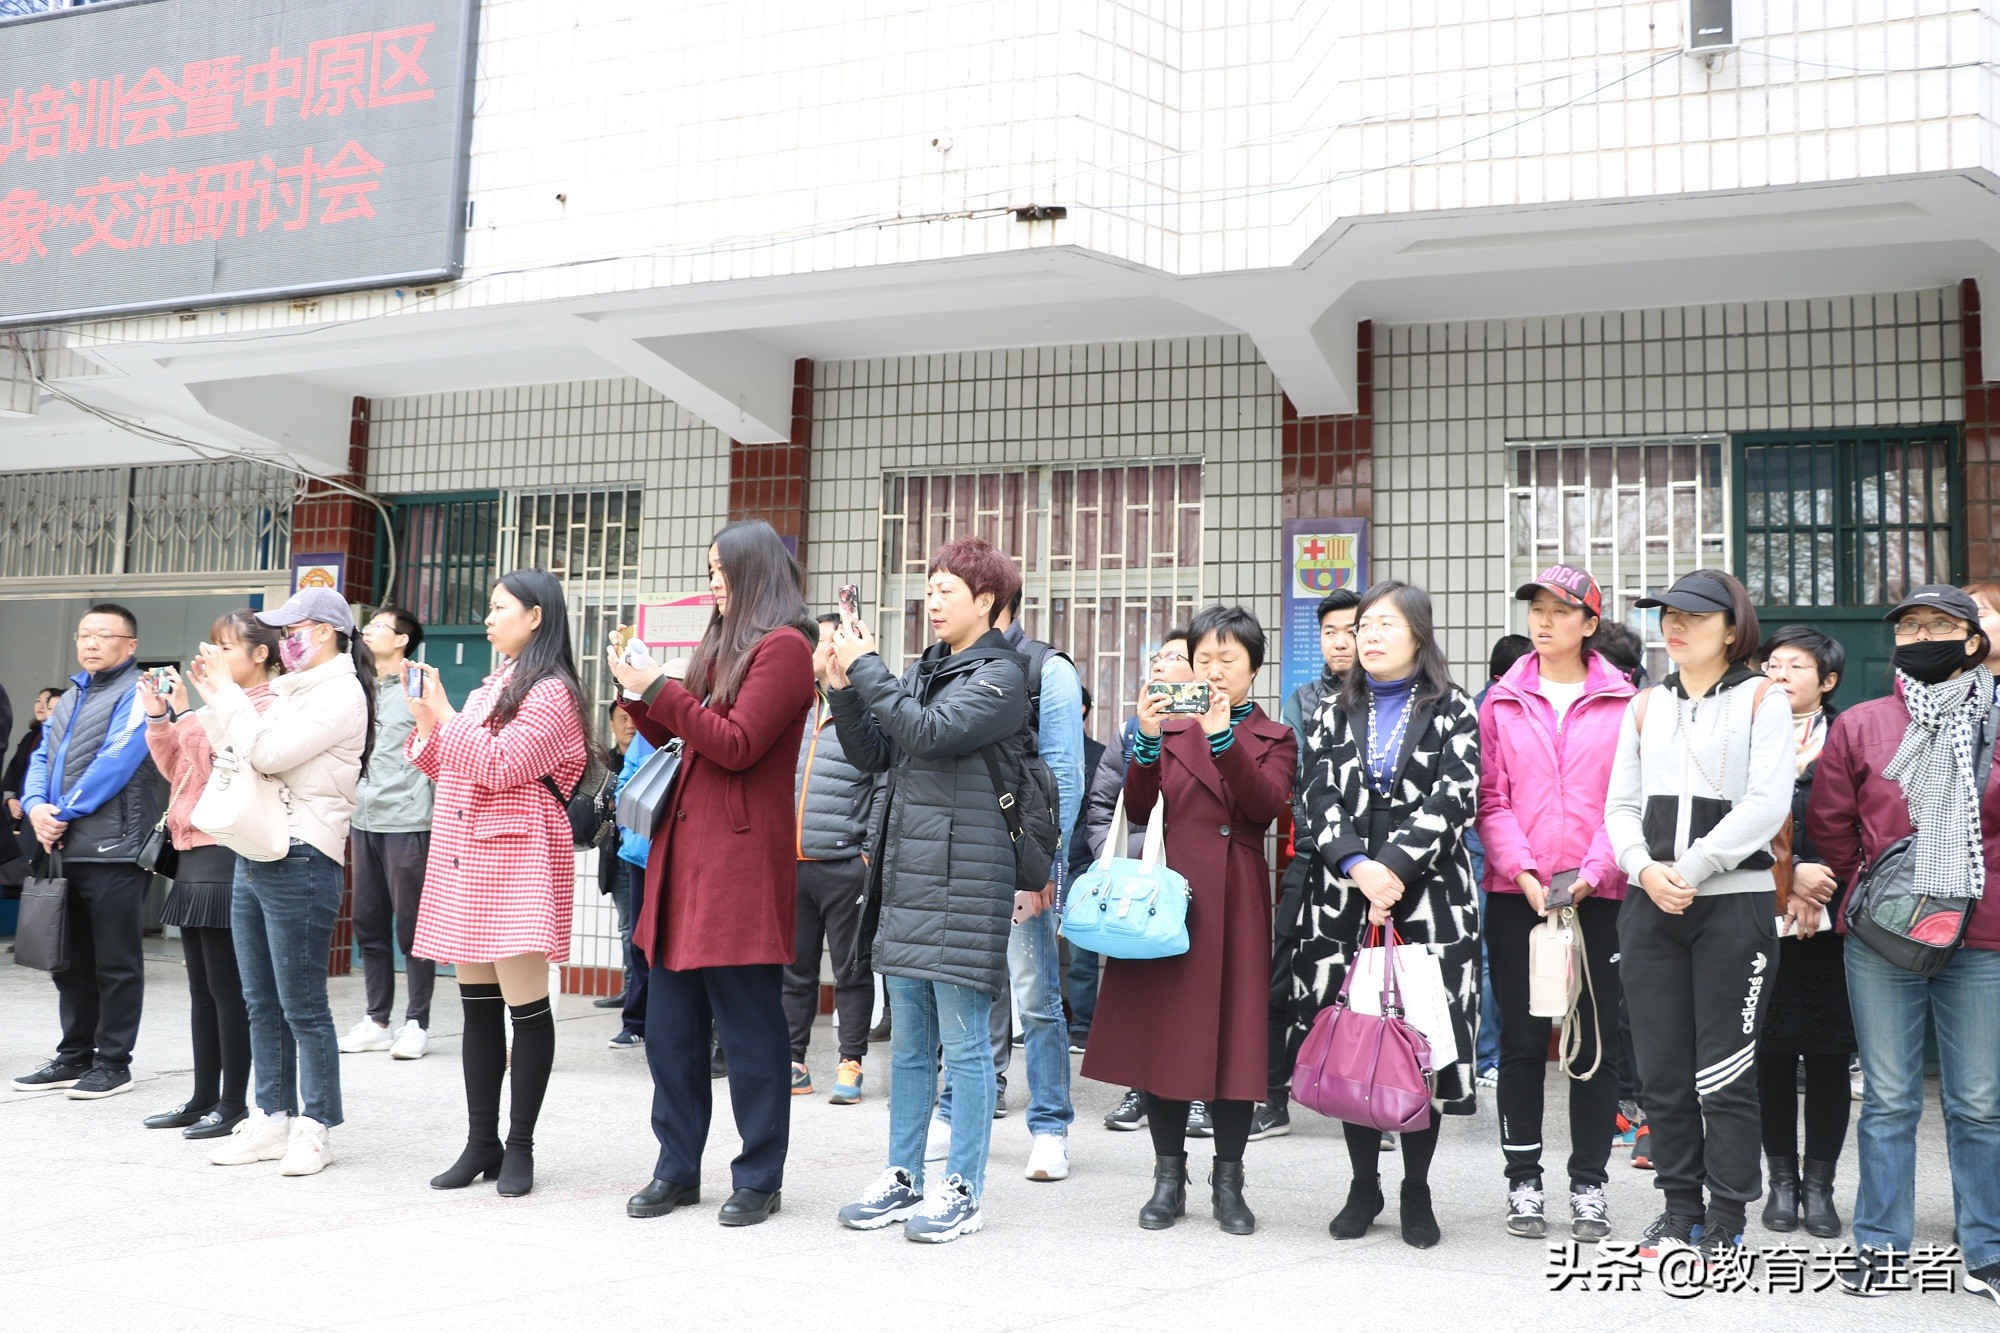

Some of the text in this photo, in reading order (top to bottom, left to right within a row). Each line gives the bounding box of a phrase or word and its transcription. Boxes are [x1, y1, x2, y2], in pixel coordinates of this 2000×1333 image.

[0, 23, 436, 165] 培训会暨中原区
[1741, 976, 1764, 1034] adidas
